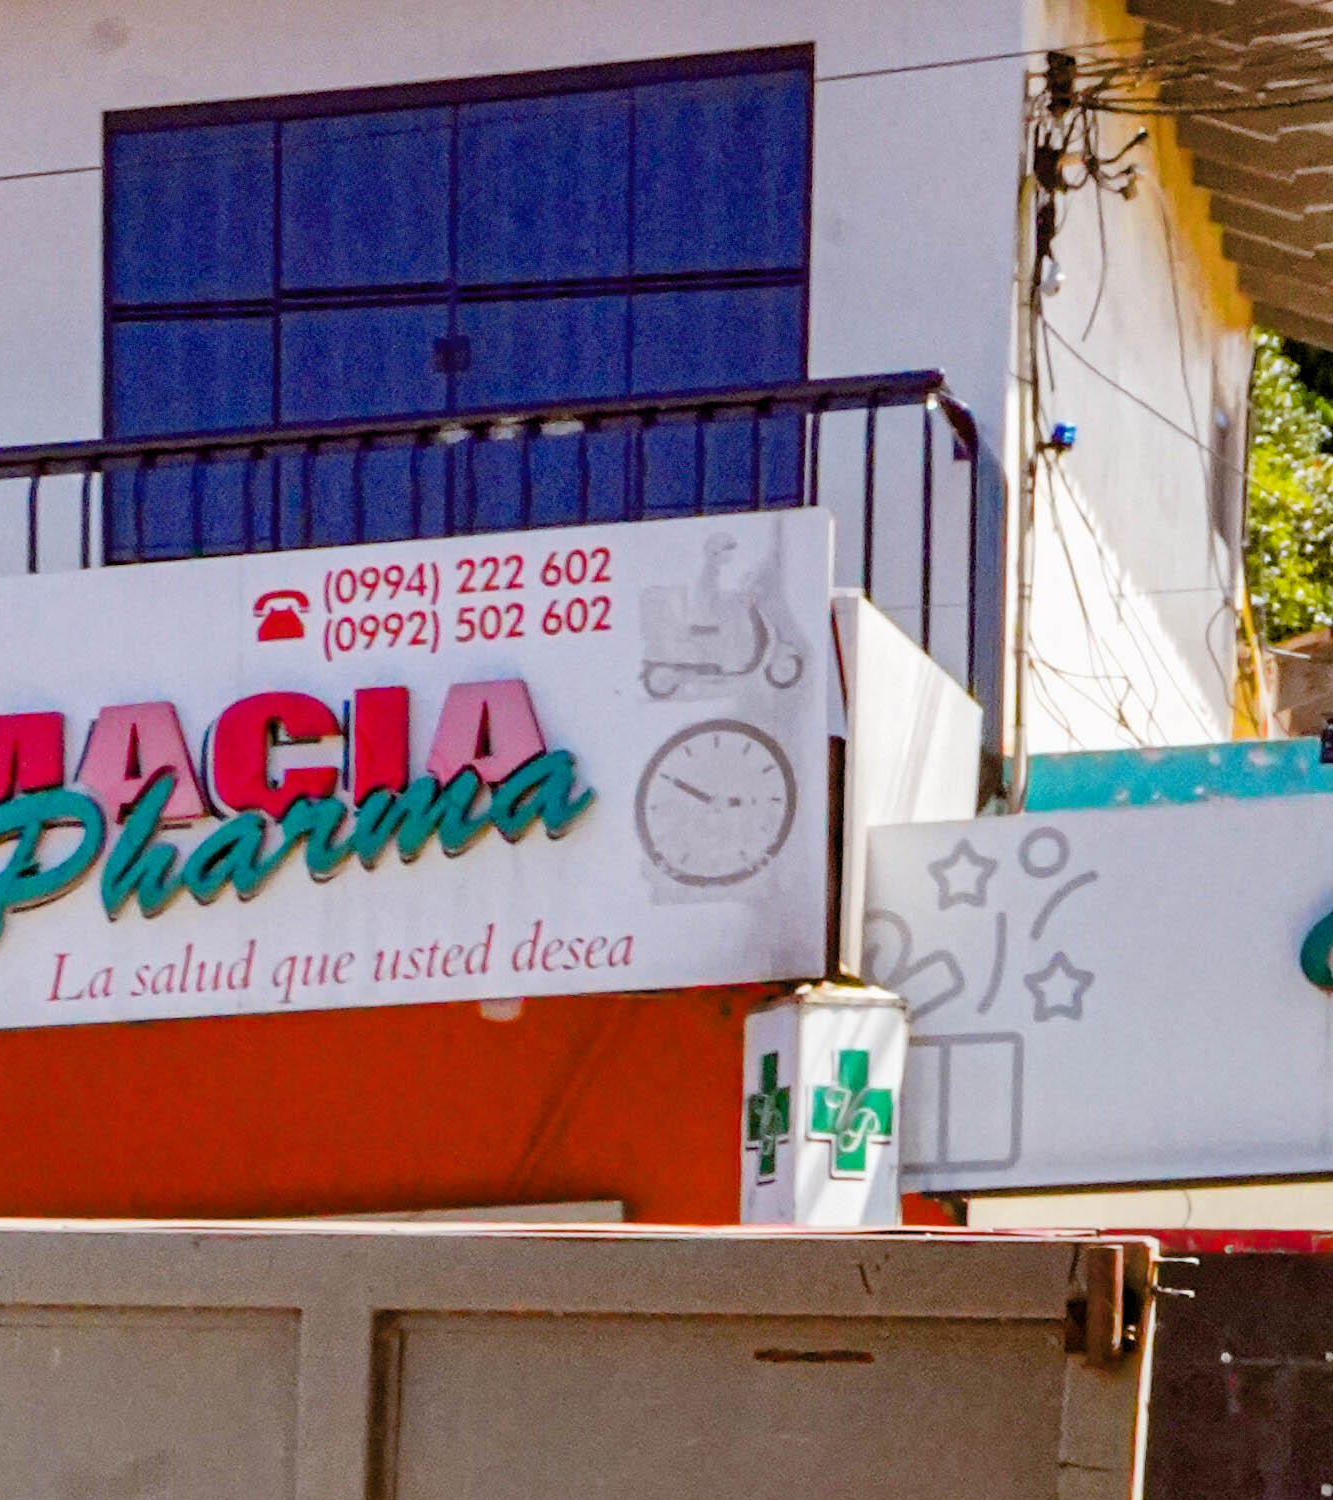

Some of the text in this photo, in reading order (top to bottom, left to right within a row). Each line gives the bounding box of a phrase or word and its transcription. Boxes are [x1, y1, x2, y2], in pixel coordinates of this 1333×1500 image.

[324, 546, 612, 614] (0994) 222 602
[324, 595, 612, 662] (0992) 502 602
[48, 920, 635, 1004] La salud que usted desea
